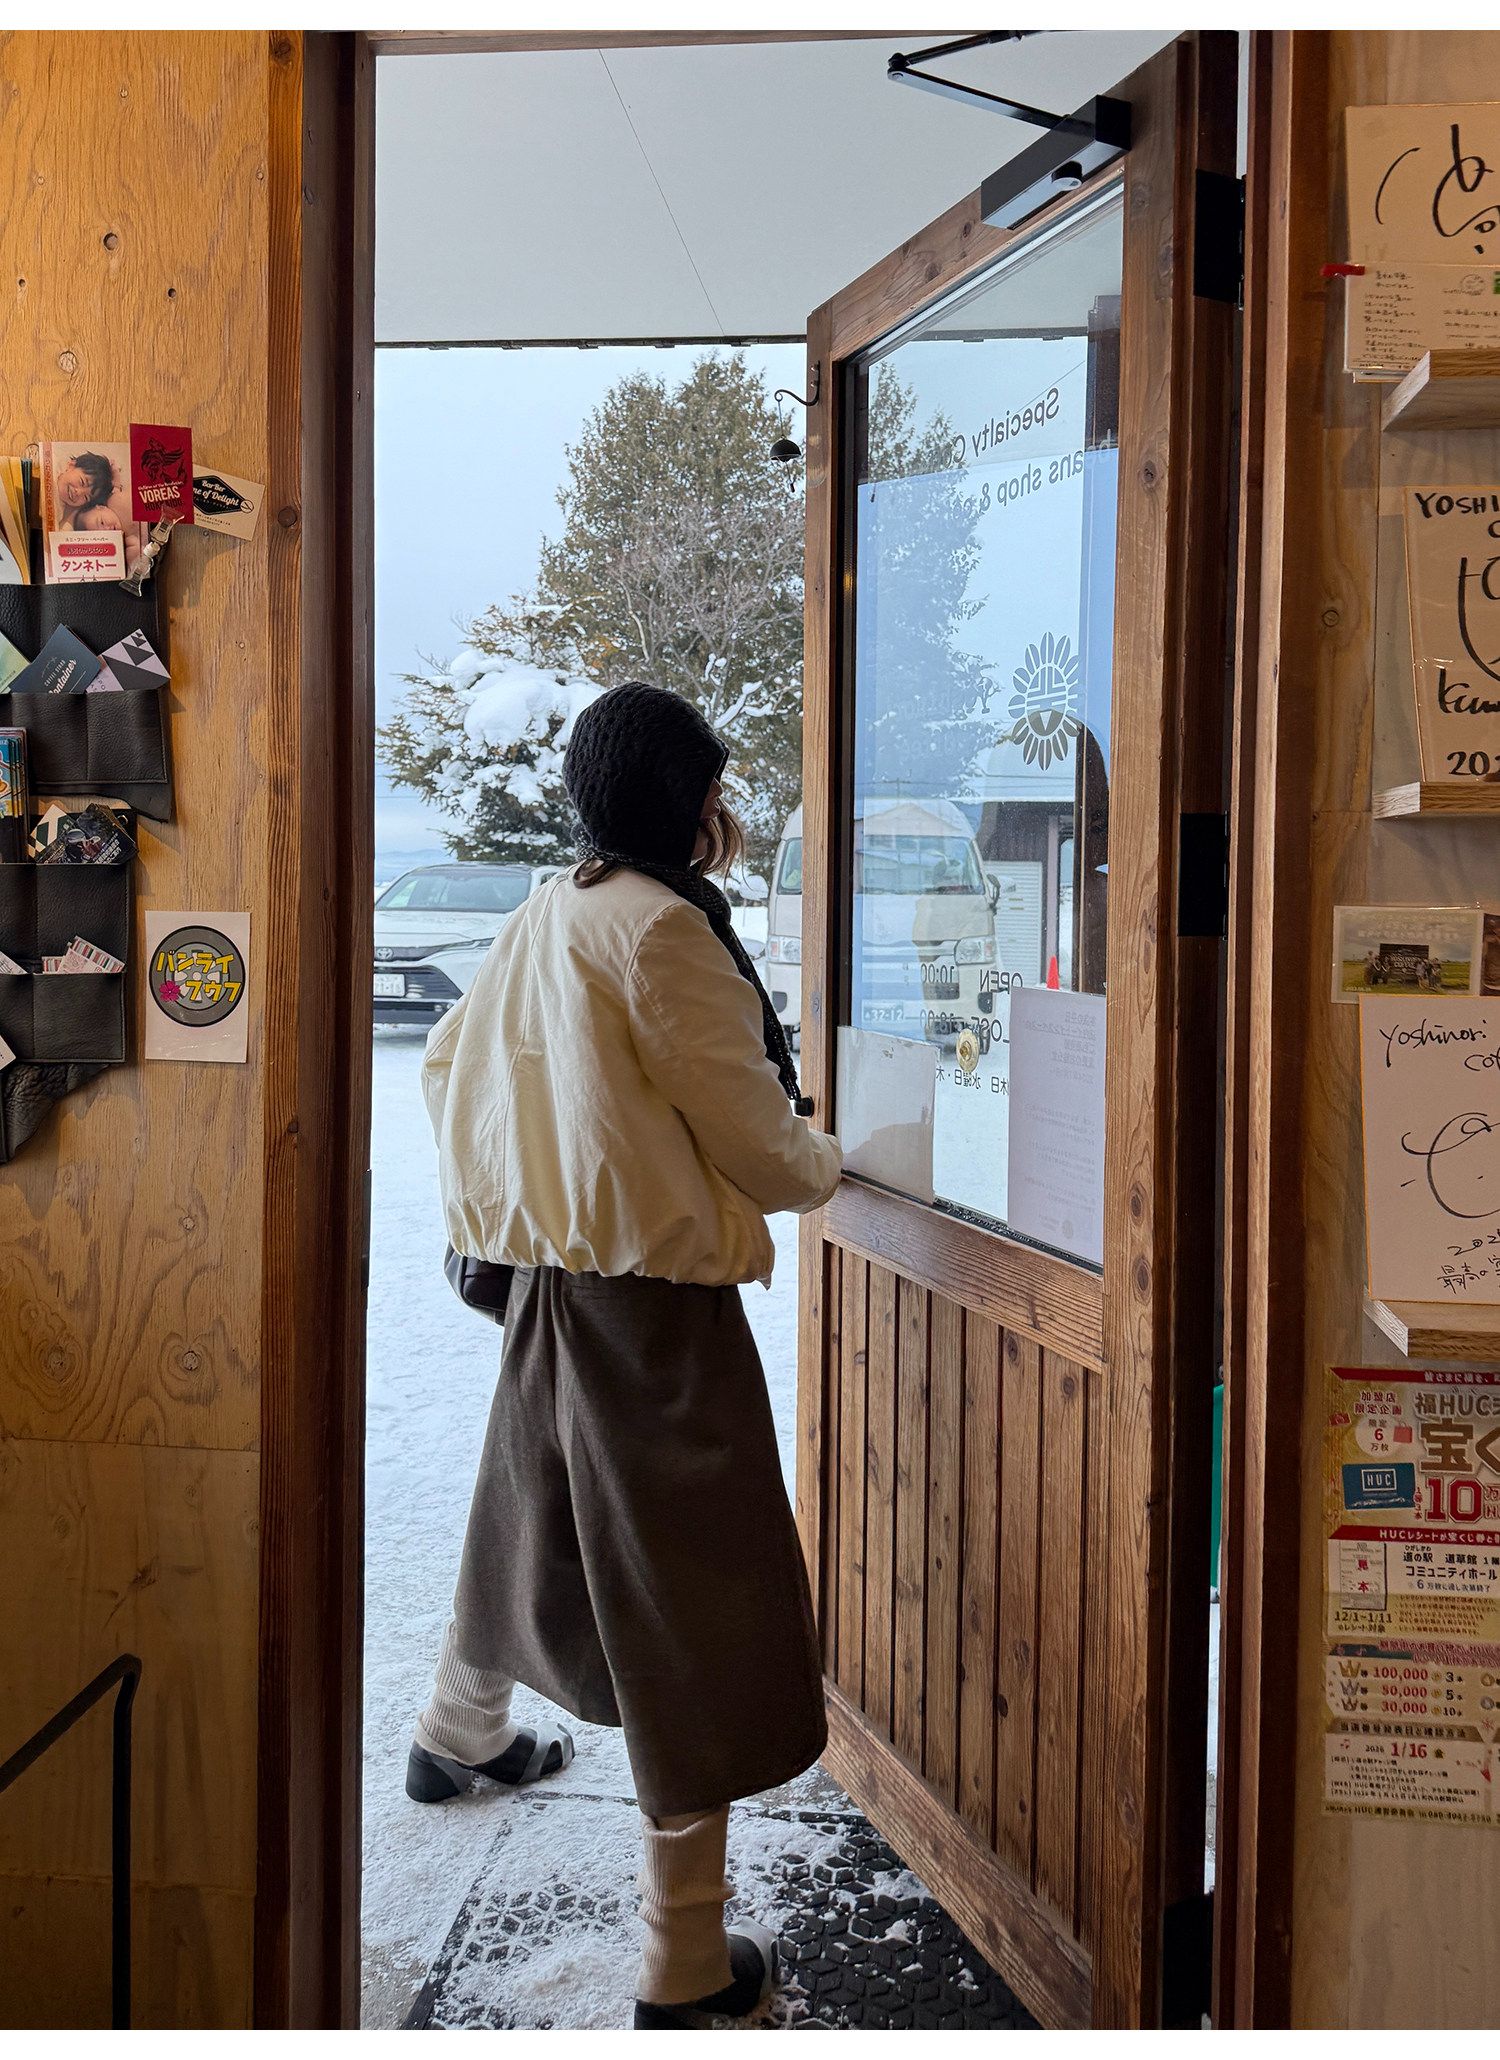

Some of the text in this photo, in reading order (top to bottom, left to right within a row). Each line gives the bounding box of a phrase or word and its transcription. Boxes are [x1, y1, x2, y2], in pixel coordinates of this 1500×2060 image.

[139, 486, 181, 503] VOREAS
[202, 489, 213, 499] of
[211, 492, 240, 506] Delight
[1415, 492, 1500, 519] YOSHI
[61, 559, 117, 572] タンネトー
[1447, 751, 1500, 776] 20
[157, 950, 234, 974] バンライ
[185, 980, 242, 1002] フウフ
[1374, 1428, 1384, 1441] 6
[1370, 1443, 1389, 1452] 万枚
[1366, 1474, 1392, 1486] HUC
[1427, 1478, 1482, 1522] 10
[1403, 1552, 1433, 1563] 道の駅
[1405, 1565, 1498, 1580] コミュニティホール
[1373, 1666, 1429, 1681] 100,000
[1381, 1684, 1428, 1698] 50,000
[1381, 1701, 1428, 1715] 30,000
[1391, 1742, 1428, 1759] 1/16
